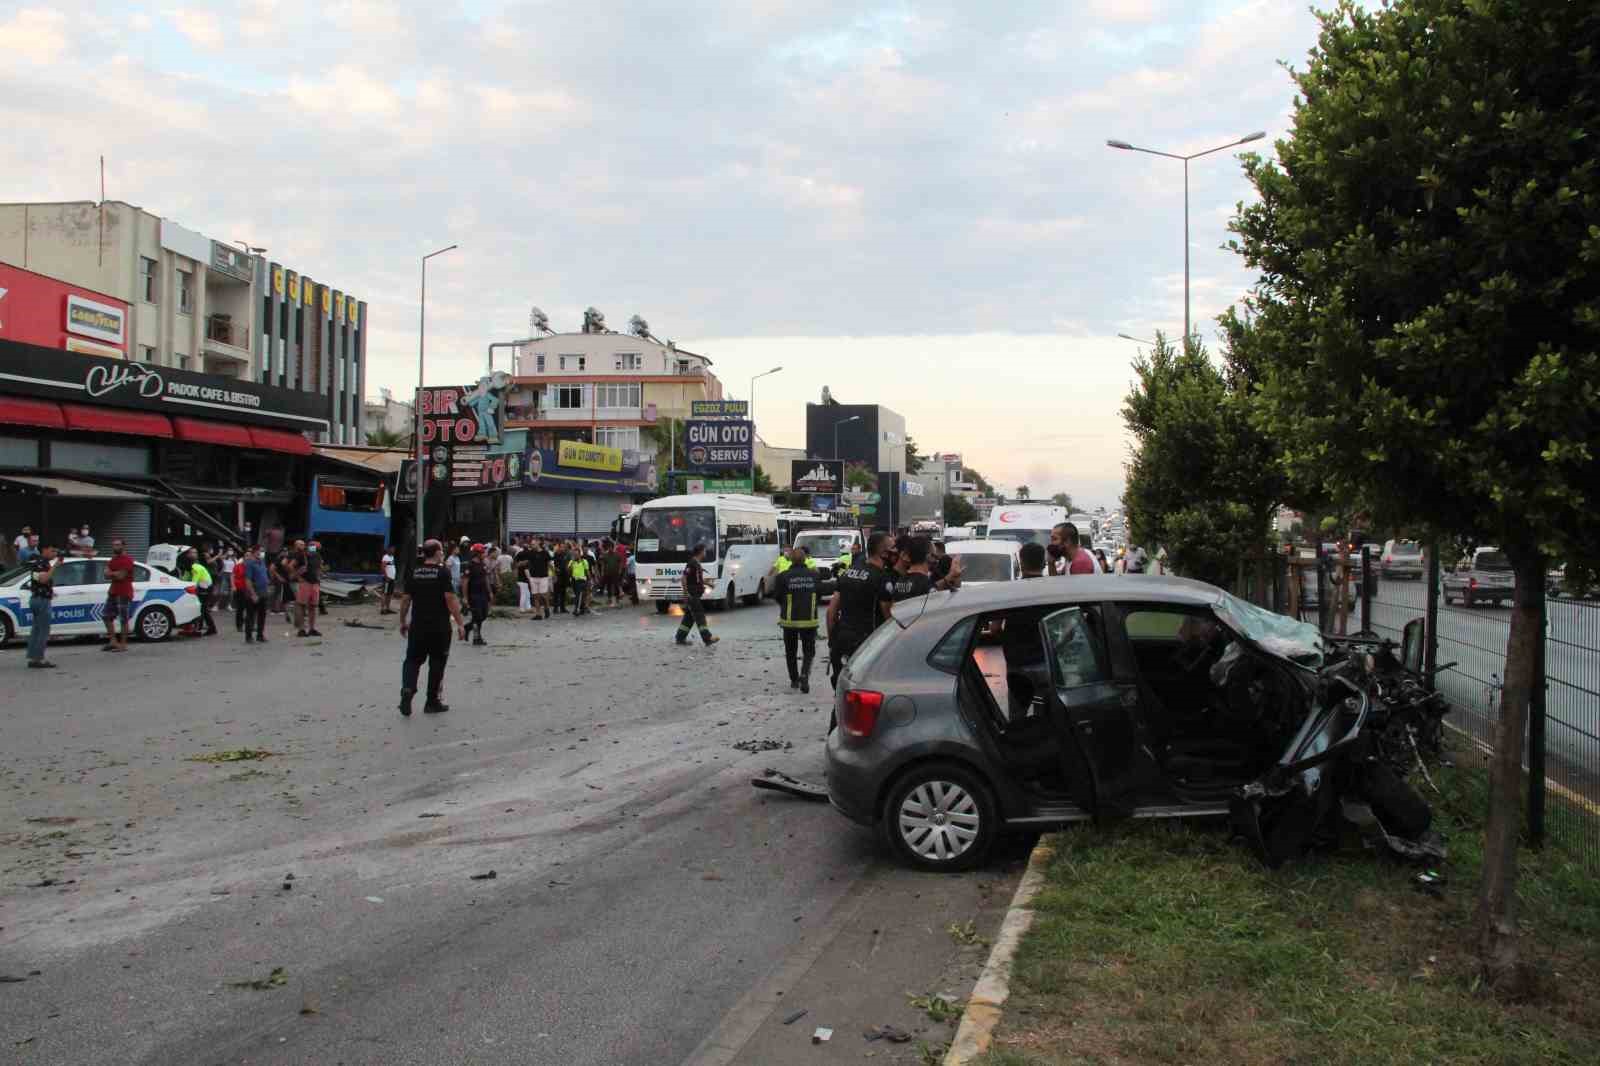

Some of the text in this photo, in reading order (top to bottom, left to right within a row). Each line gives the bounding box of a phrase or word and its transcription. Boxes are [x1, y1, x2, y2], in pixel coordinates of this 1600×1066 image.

[273, 268, 357, 322] GÜN OTO
[168, 381, 200, 398] PADOK
[200, 387, 224, 402] CAFE
[689, 424, 749, 443] GÜN OTO
